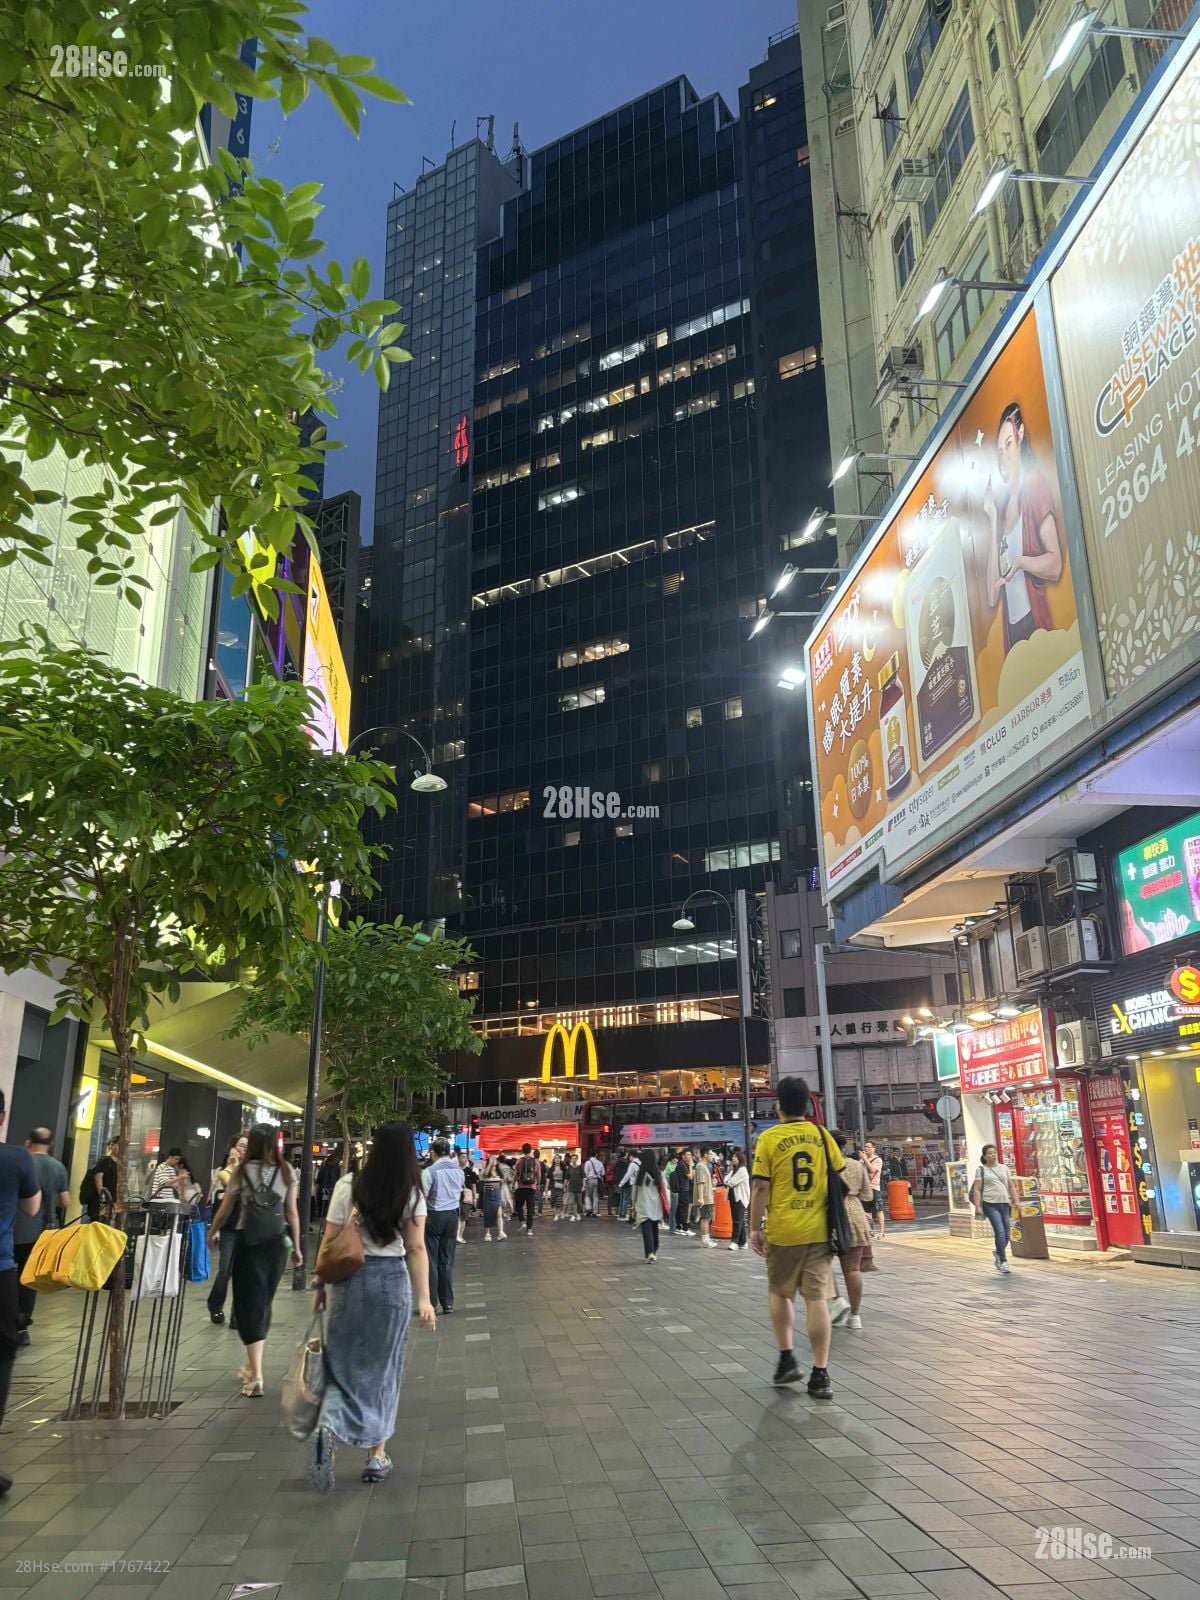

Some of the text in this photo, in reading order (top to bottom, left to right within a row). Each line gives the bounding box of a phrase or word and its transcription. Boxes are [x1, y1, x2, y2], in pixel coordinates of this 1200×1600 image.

[1096, 290, 1189, 435] CAUSEWAY
[1122, 315, 1195, 425] PLACE
[1097, 413, 1164, 495] LEASING
[1102, 444, 1168, 539] 2864
[986, 726, 1007, 750] CLUB
[850, 753, 869, 782] 100%
[850, 775, 871, 804] 日本製
[1125, 994, 1151, 1011] HONG
[480, 1108, 537, 1121] McDonald's
[792, 1151, 814, 1193] 6
